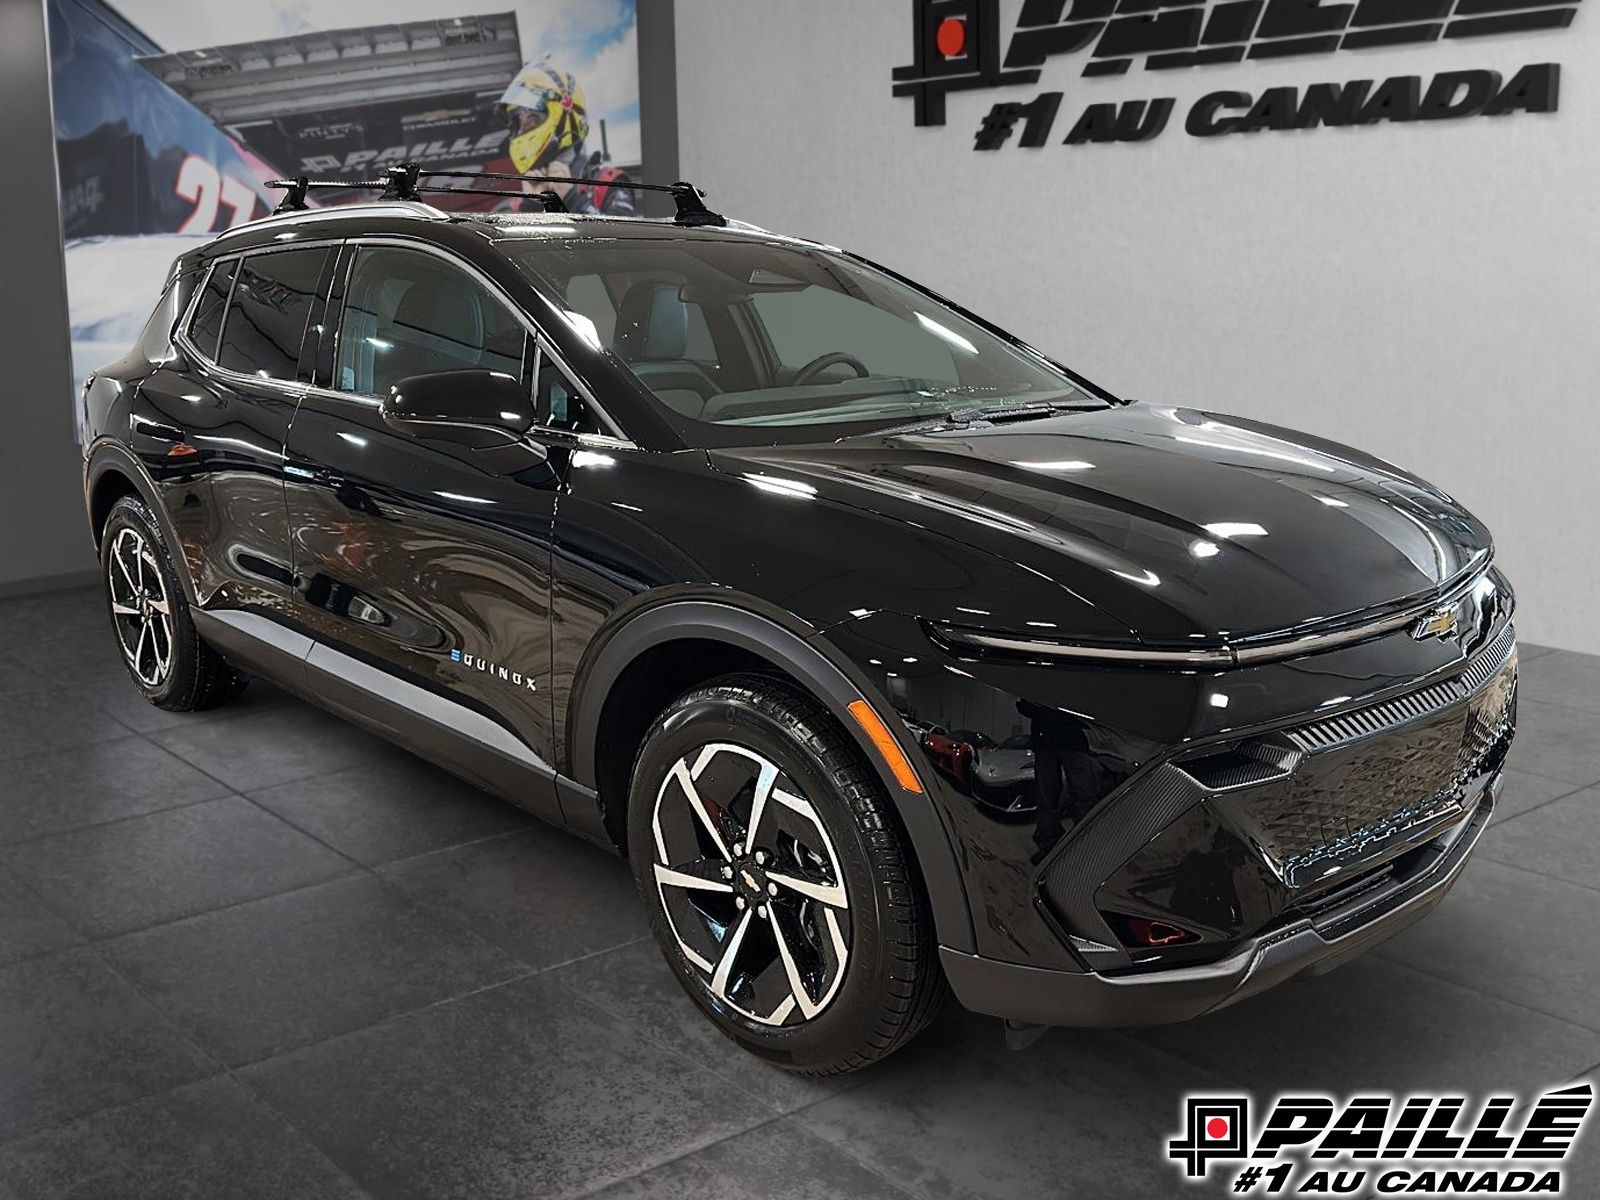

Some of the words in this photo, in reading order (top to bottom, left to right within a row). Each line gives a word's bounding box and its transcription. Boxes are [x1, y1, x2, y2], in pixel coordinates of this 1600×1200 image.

[973, 91, 1064, 151] #1
[1061, 97, 1177, 145] AU
[1185, 62, 1561, 138] CANADA
[450, 648, 538, 692] EQUINOX
